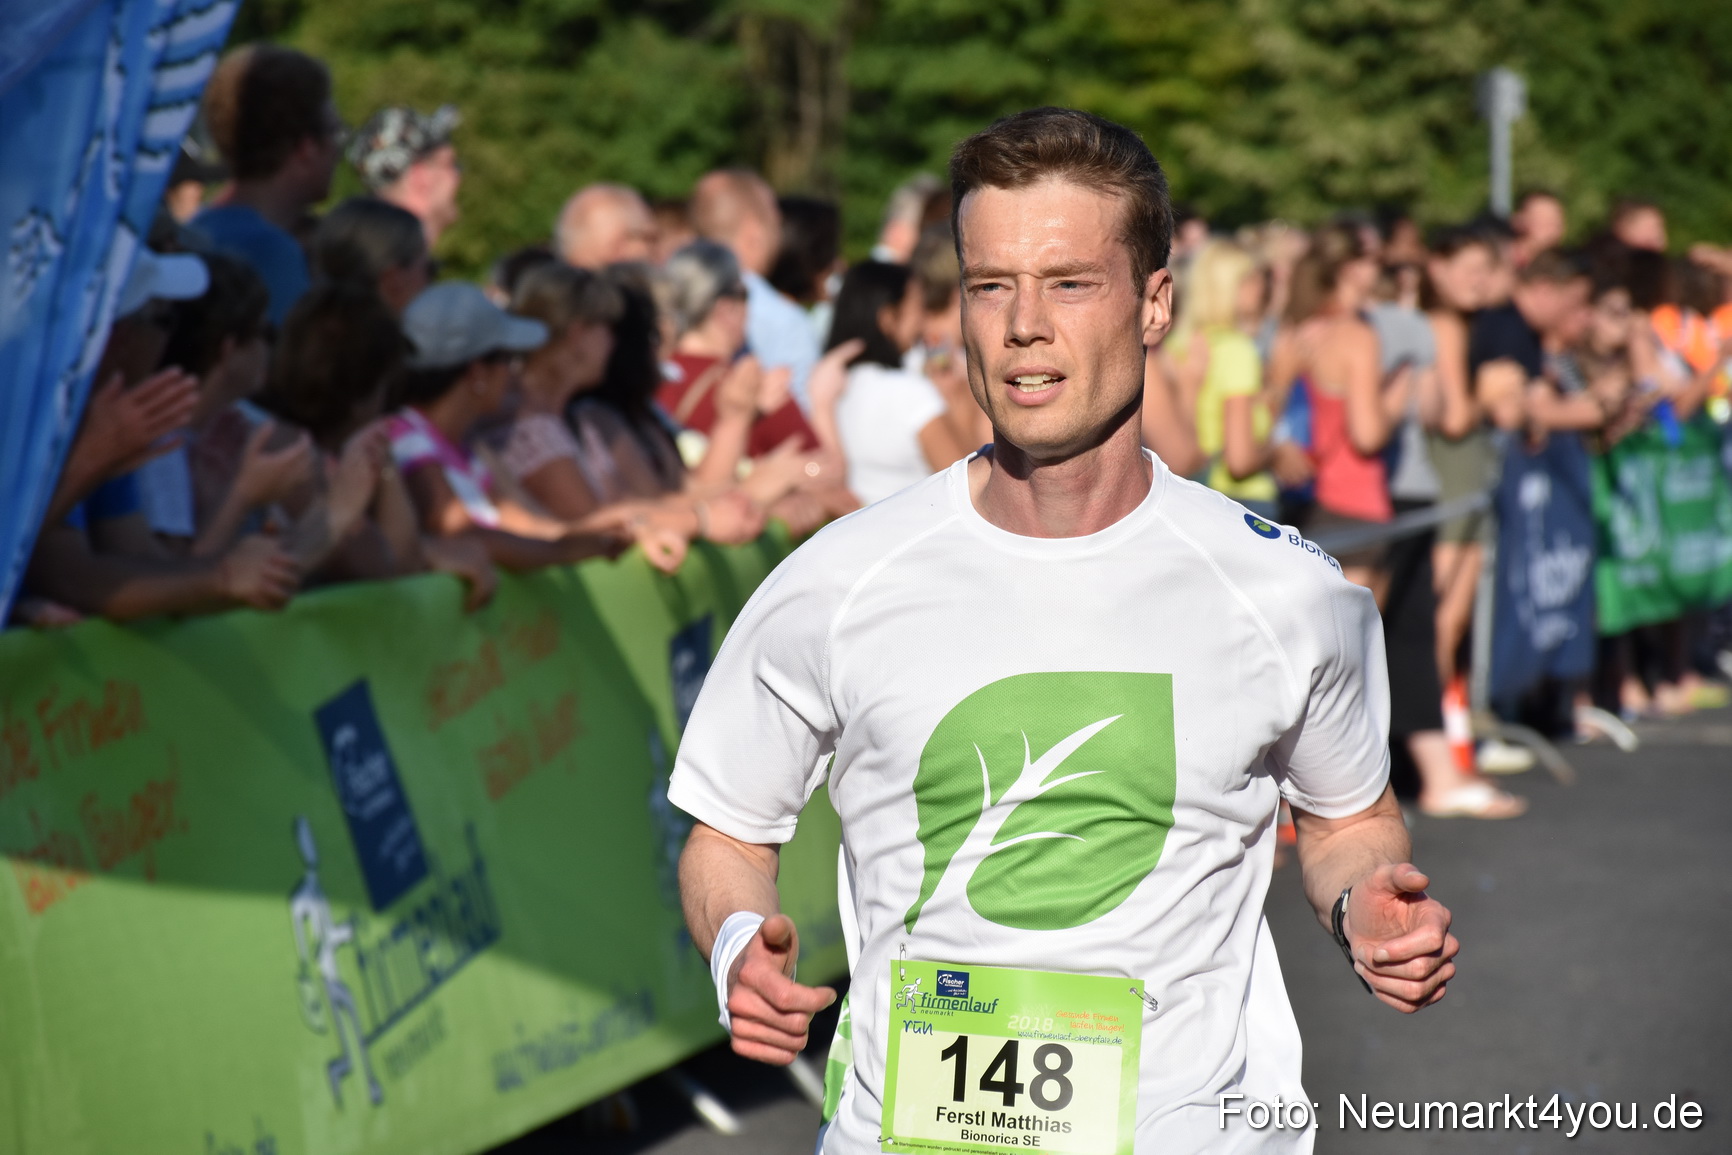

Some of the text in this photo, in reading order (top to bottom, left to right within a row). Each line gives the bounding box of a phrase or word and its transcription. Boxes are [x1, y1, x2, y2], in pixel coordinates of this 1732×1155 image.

[920, 1009, 954, 1017] neumarkt
[921, 992, 999, 1014] firmenlauf
[1007, 1015, 1054, 1032] 2018
[941, 1035, 1074, 1111] 148
[936, 1106, 1072, 1134] Ferstl Matthias
[961, 1129, 1041, 1147] Bionorica SE
